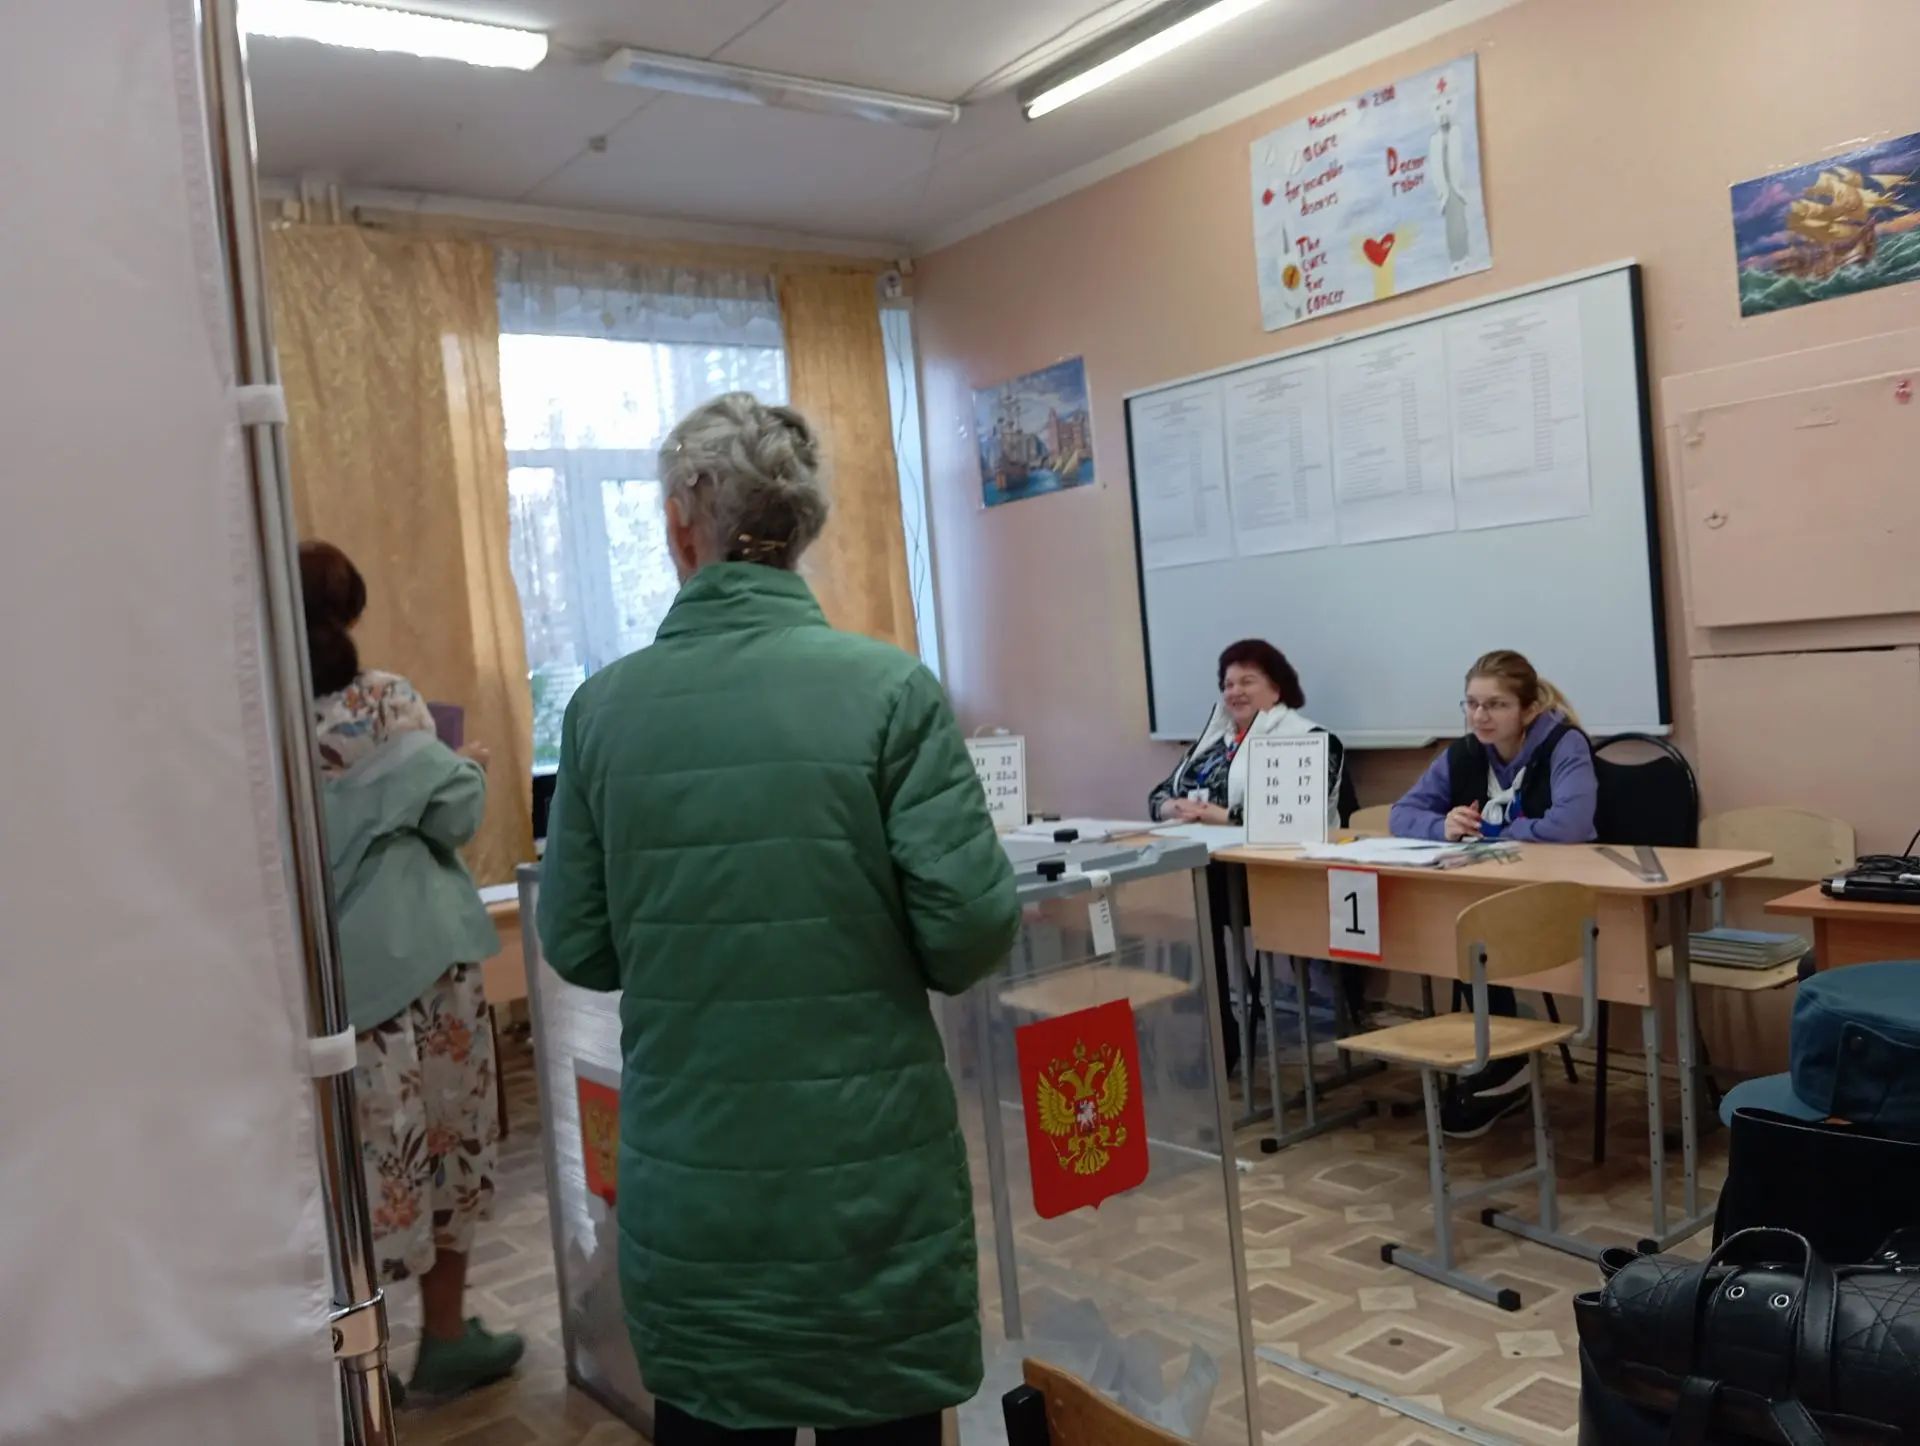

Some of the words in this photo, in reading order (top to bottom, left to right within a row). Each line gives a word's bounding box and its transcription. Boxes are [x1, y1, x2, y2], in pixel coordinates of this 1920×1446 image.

[1266, 758, 1280, 769] 14
[1298, 757, 1312, 769] 15
[1266, 777, 1280, 788] 16
[1298, 775, 1312, 787] 17
[1266, 795, 1279, 806] 18
[1298, 794, 1312, 805] 19
[1278, 813, 1293, 825] 20
[1343, 891, 1366, 935] 1
